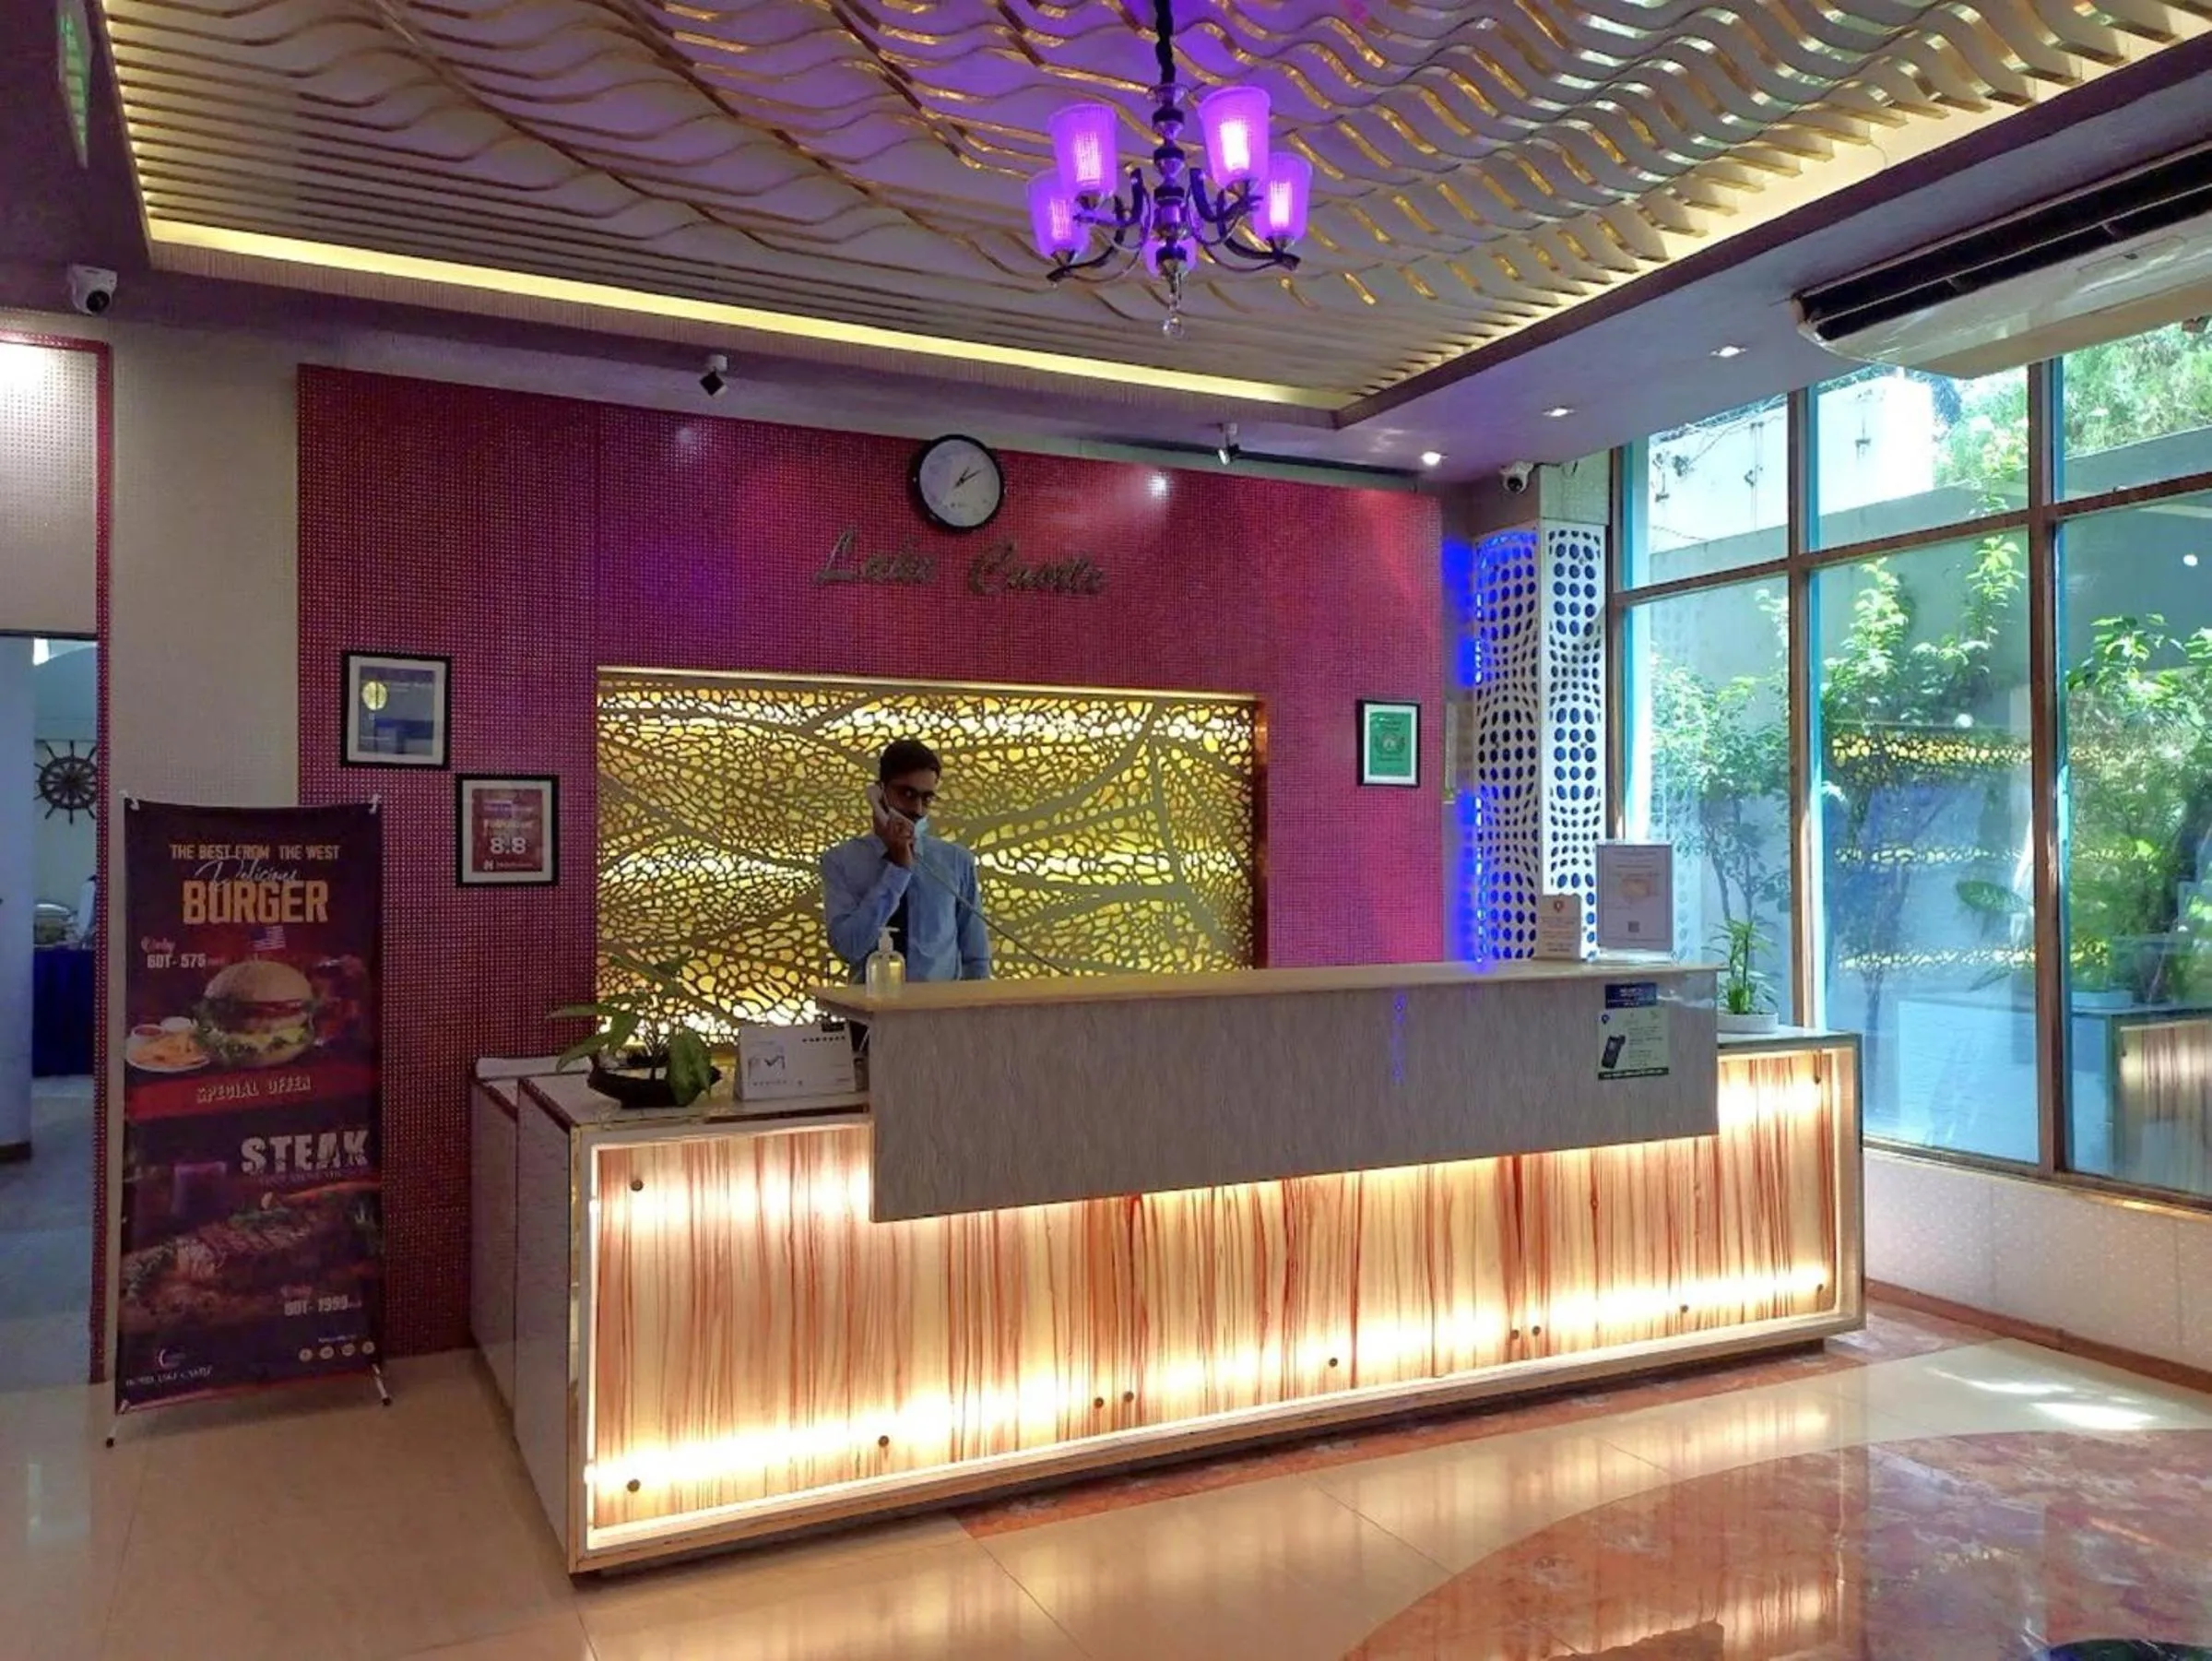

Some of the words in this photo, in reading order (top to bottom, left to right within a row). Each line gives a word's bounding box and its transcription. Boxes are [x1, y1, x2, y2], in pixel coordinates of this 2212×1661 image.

[170, 844, 195, 860] THE
[198, 844, 231, 860] BEST
[235, 844, 269, 860] FROM
[278, 844, 302, 860] THE
[305, 844, 341, 860] WEST
[490, 836, 527, 856] 8.8
[182, 880, 329, 924] BURGER
[241, 1130, 369, 1174] STEAK
